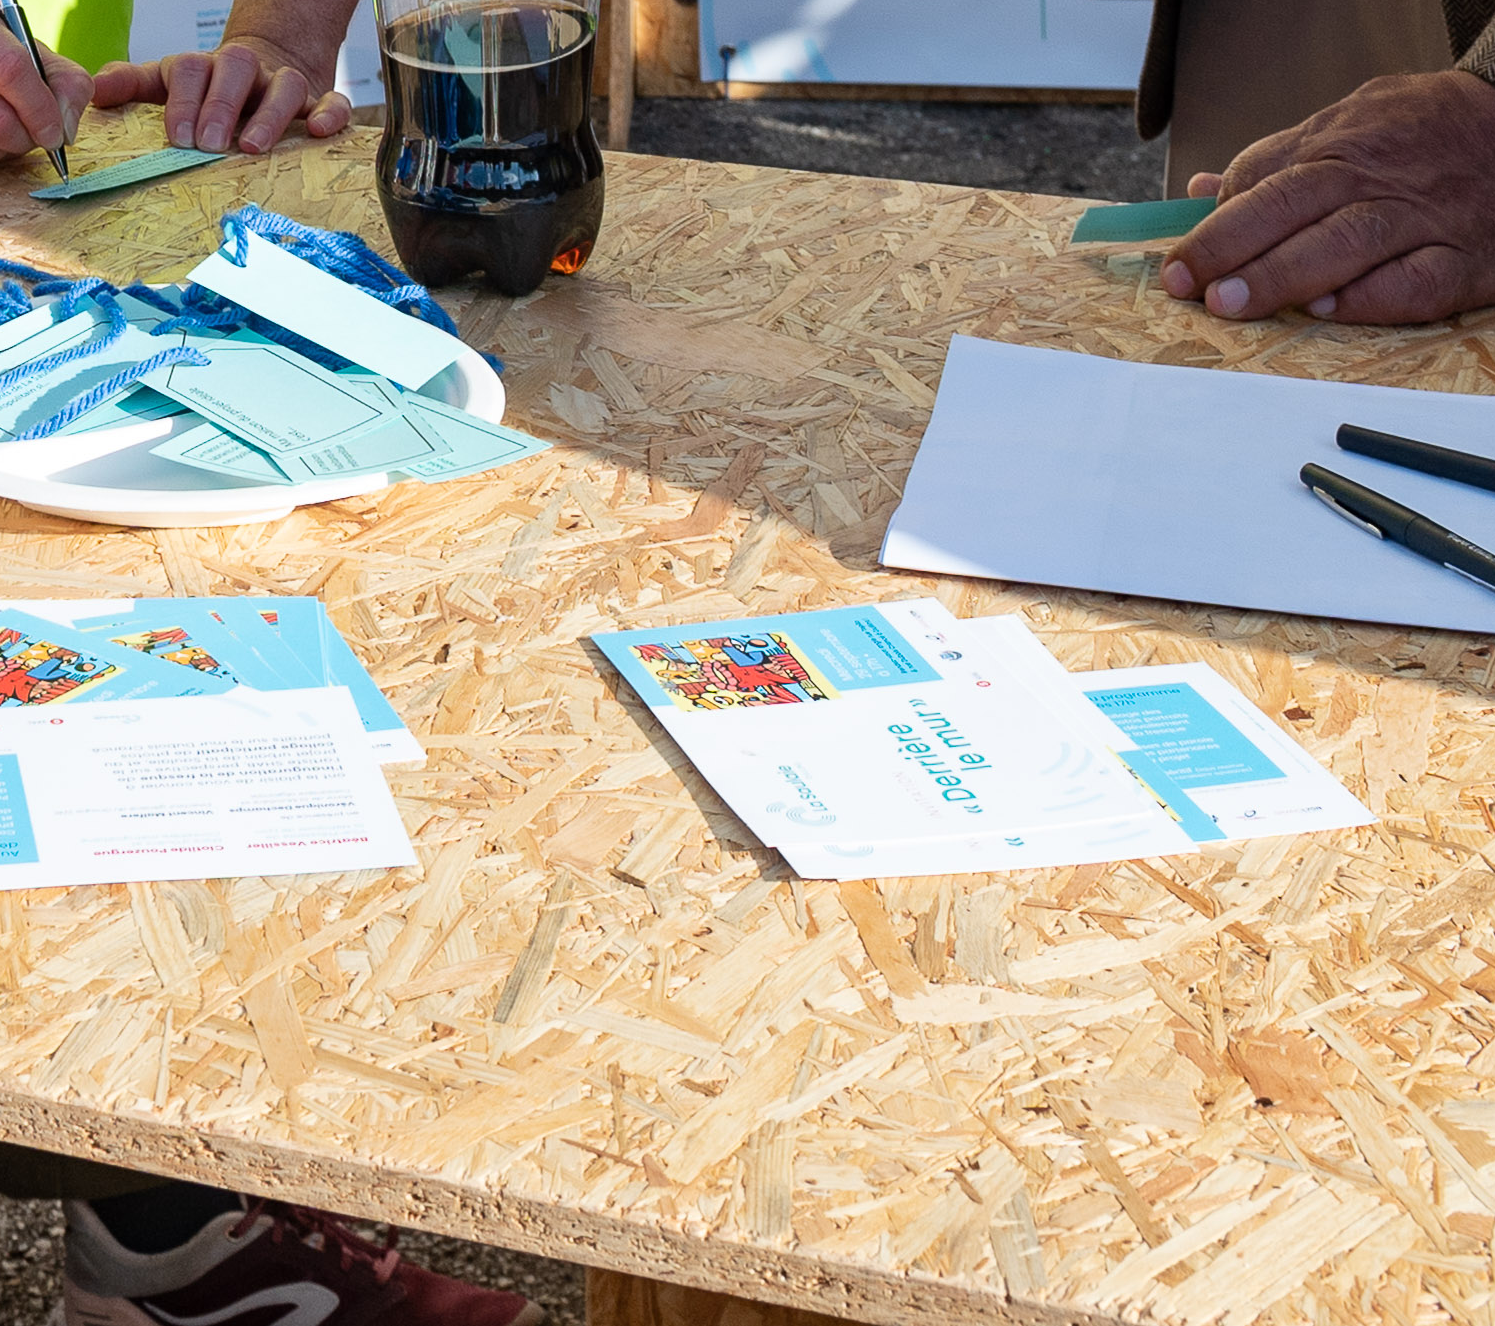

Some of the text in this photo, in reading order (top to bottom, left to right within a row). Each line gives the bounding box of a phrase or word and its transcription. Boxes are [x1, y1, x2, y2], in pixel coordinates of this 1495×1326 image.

[1103, 687, 1181, 701] programme
[915, 711, 972, 749] mur
[887, 722, 977, 802] Derrière
[958, 753, 993, 772] le
[778, 763, 829, 812] La Saulaie
[171, 844, 225, 854] Clotilde
[309, 836, 369, 846] Béatrice
[3, 849, 21, 858] Au
